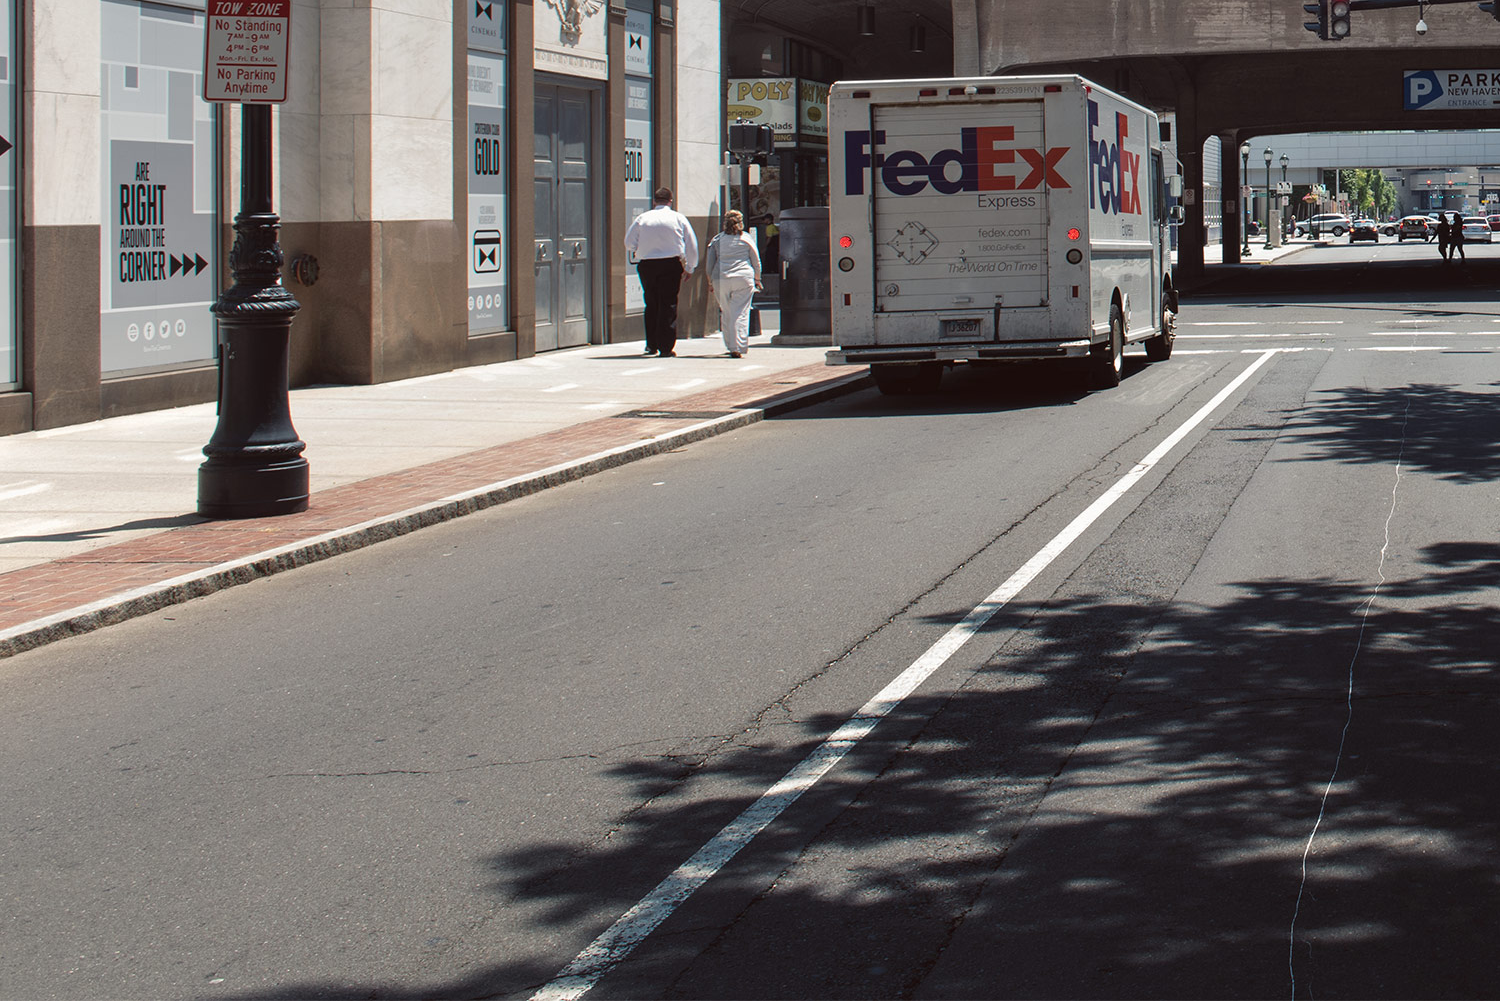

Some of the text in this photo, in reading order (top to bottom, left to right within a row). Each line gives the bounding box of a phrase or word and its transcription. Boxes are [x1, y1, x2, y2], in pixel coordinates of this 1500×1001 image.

[215, 2, 284, 16] TOW ZONE
[216, 19, 282, 35] No Standing
[471, 26, 496, 36] CINEMAS
[217, 68, 276, 84] No Parking
[224, 82, 268, 95] Anytime
[737, 81, 792, 101] POLY
[728, 109, 756, 117] original
[475, 138, 500, 175] GOLD
[844, 126, 1072, 196] FedEx
[1088, 100, 1142, 215] FedEx
[136, 162, 150, 181] ARE
[625, 150, 642, 182] GOLD
[120, 184, 166, 225] RIGHT
[978, 194, 1036, 210] Express
[120, 228, 165, 248] AROUND THE
[978, 228, 1031, 238] fedex.com
[119, 251, 166, 283] CORNER
[948, 262, 1037, 273] The World On Time
